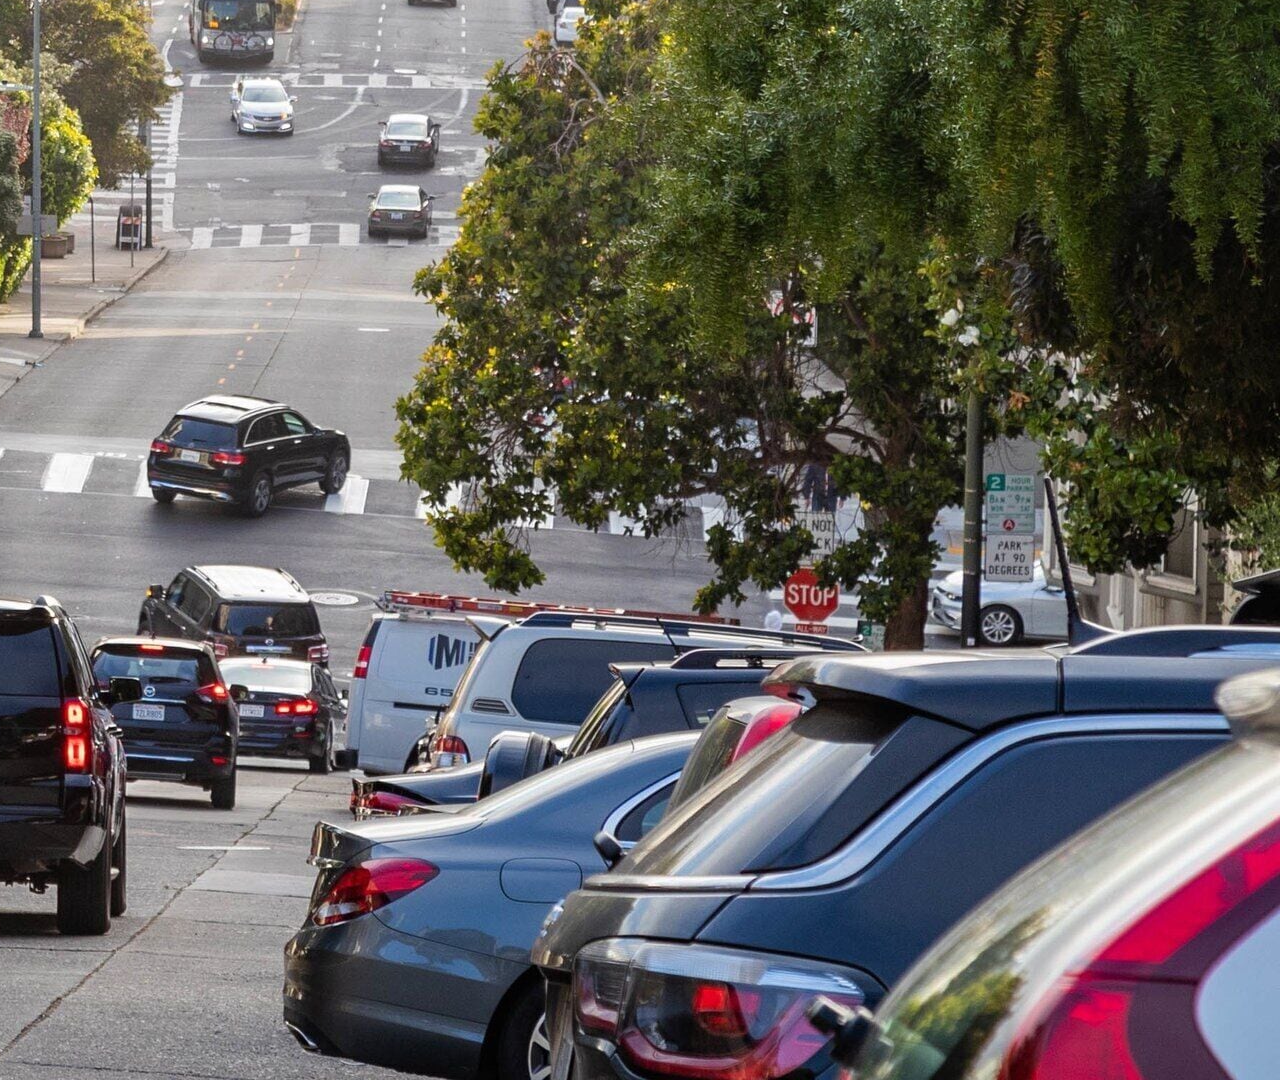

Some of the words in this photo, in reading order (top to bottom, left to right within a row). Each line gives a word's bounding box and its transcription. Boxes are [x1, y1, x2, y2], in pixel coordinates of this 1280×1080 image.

[991, 476, 1001, 489] 2
[811, 519, 832, 533] NOT
[1004, 520, 1014, 530] A
[997, 540, 1022, 551] PARK
[994, 553, 1006, 563] AT
[1012, 553, 1026, 564] 90
[988, 565, 1030, 576] DEGREES
[787, 584, 836, 607] STOP
[796, 623, 827, 634] ALL-WAY
